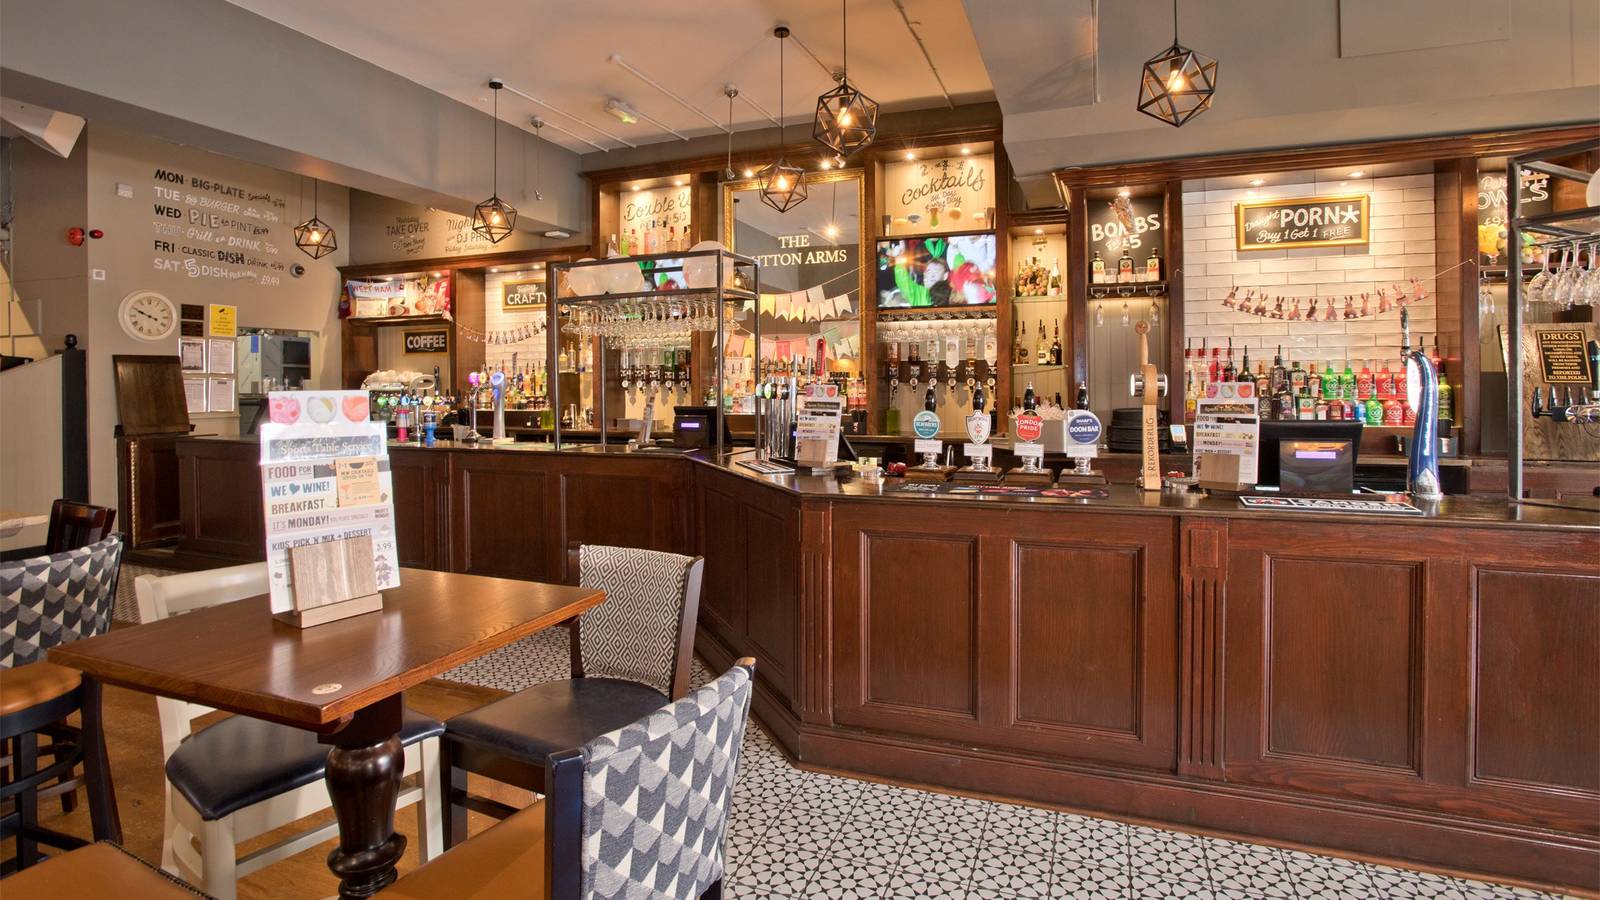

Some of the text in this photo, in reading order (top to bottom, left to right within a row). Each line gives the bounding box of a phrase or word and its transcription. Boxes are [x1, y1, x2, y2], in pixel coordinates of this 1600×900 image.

[154, 168, 184, 186] MON
[191, 178, 245, 200] BIG-PLATE
[902, 167, 986, 206] Cocktails
[154, 186, 181, 202] TUE
[199, 197, 241, 215] BURGER
[623, 196, 675, 222] Double
[154, 204, 182, 219] WED
[188, 207, 221, 229] PIE
[231, 219, 252, 233] PINT
[778, 234, 810, 249] THE
[1257, 229, 1281, 243] Buy
[1291, 227, 1309, 240] Get
[1323, 226, 1351, 240] FREE
[154, 240, 175, 254] FRI
[181, 245, 216, 260] CLASSIC
[217, 250, 245, 265] DISH
[227, 236, 261, 252] DRINK
[805, 249, 848, 265] ARMS
[153, 258, 182, 272] SAT
[201, 266, 229, 280] DISH
[406, 334, 446, 349] COFFEE
[268, 465, 297, 479] FOOD
[271, 481, 330, 497] WE WINE!
[271, 498, 325, 515] BREAKFAST
[287, 516, 329, 529] MONDAY!
[272, 541, 290, 551] KIDS
[343, 528, 372, 540] DESSERT
